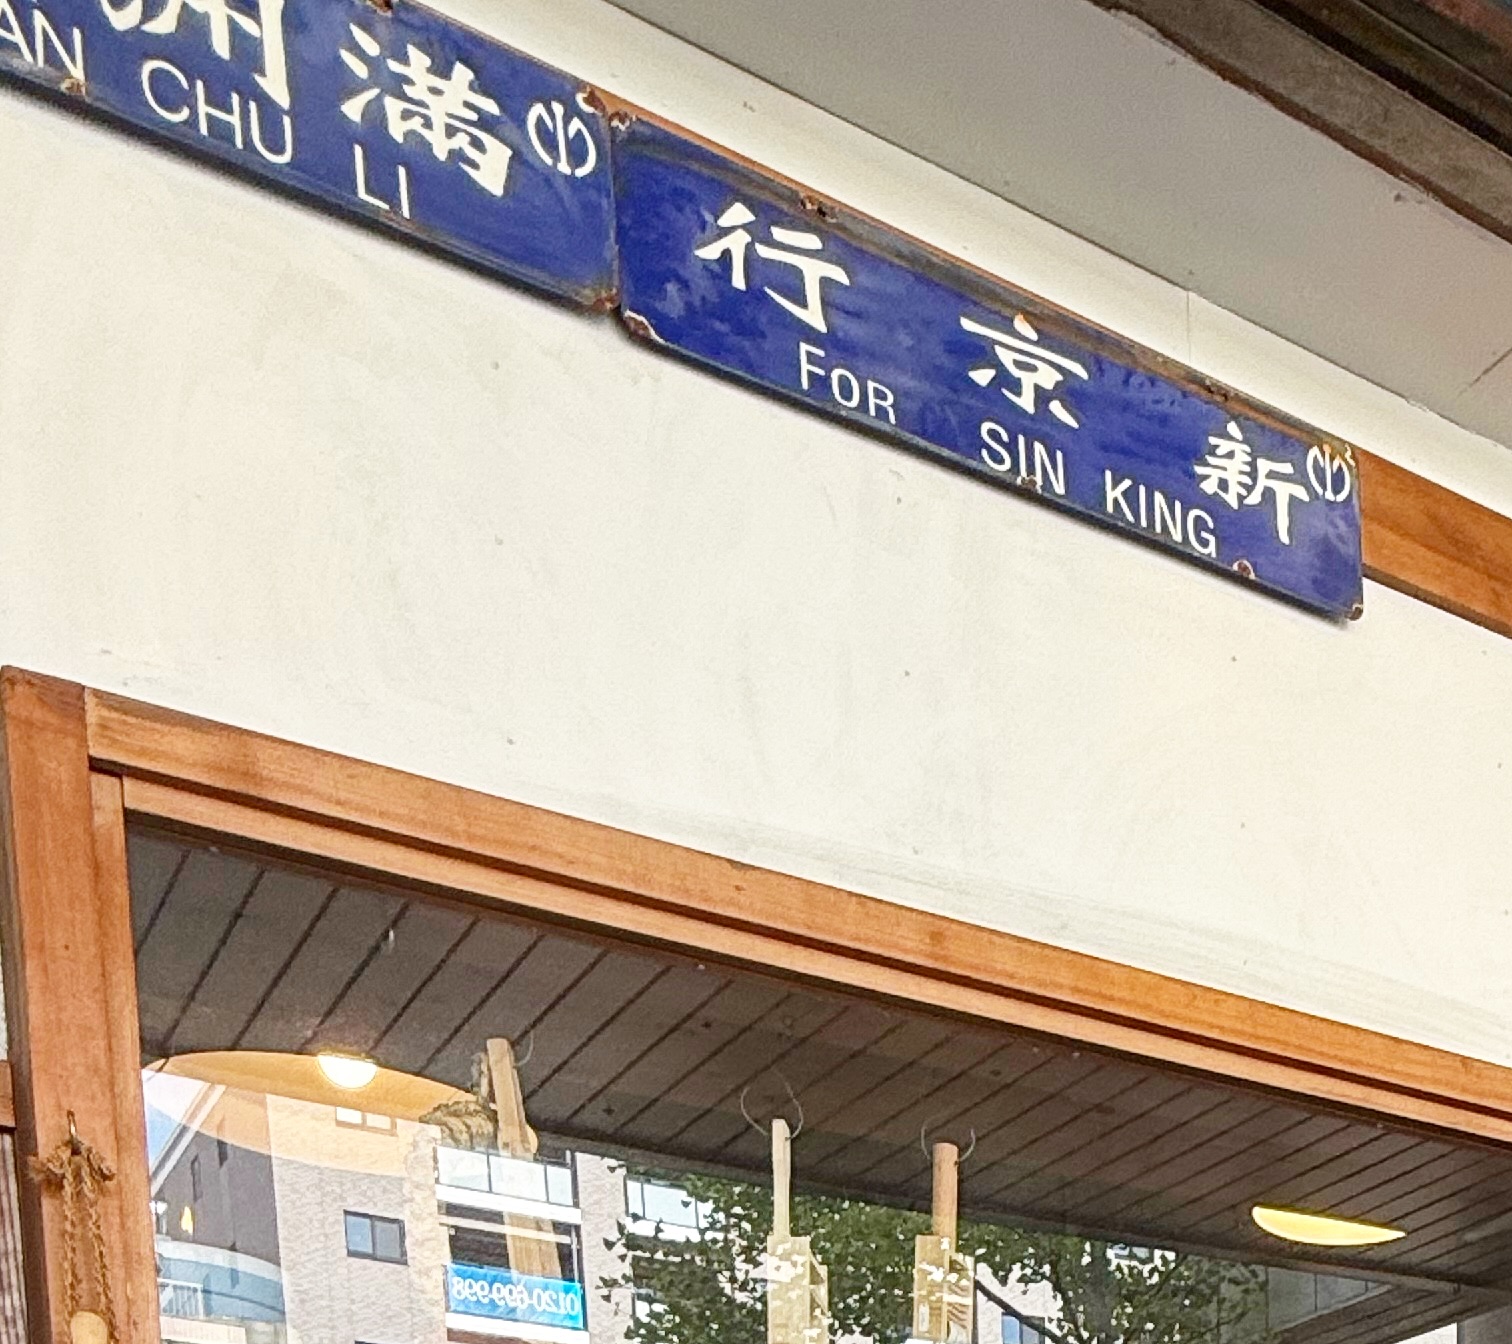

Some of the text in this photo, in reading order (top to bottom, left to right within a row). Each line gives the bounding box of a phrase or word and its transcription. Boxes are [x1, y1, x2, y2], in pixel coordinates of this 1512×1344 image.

[142, 59, 293, 163] CHU
[354, 145, 410, 219] LI
[798, 341, 1217, 558] FOR SIN KING
